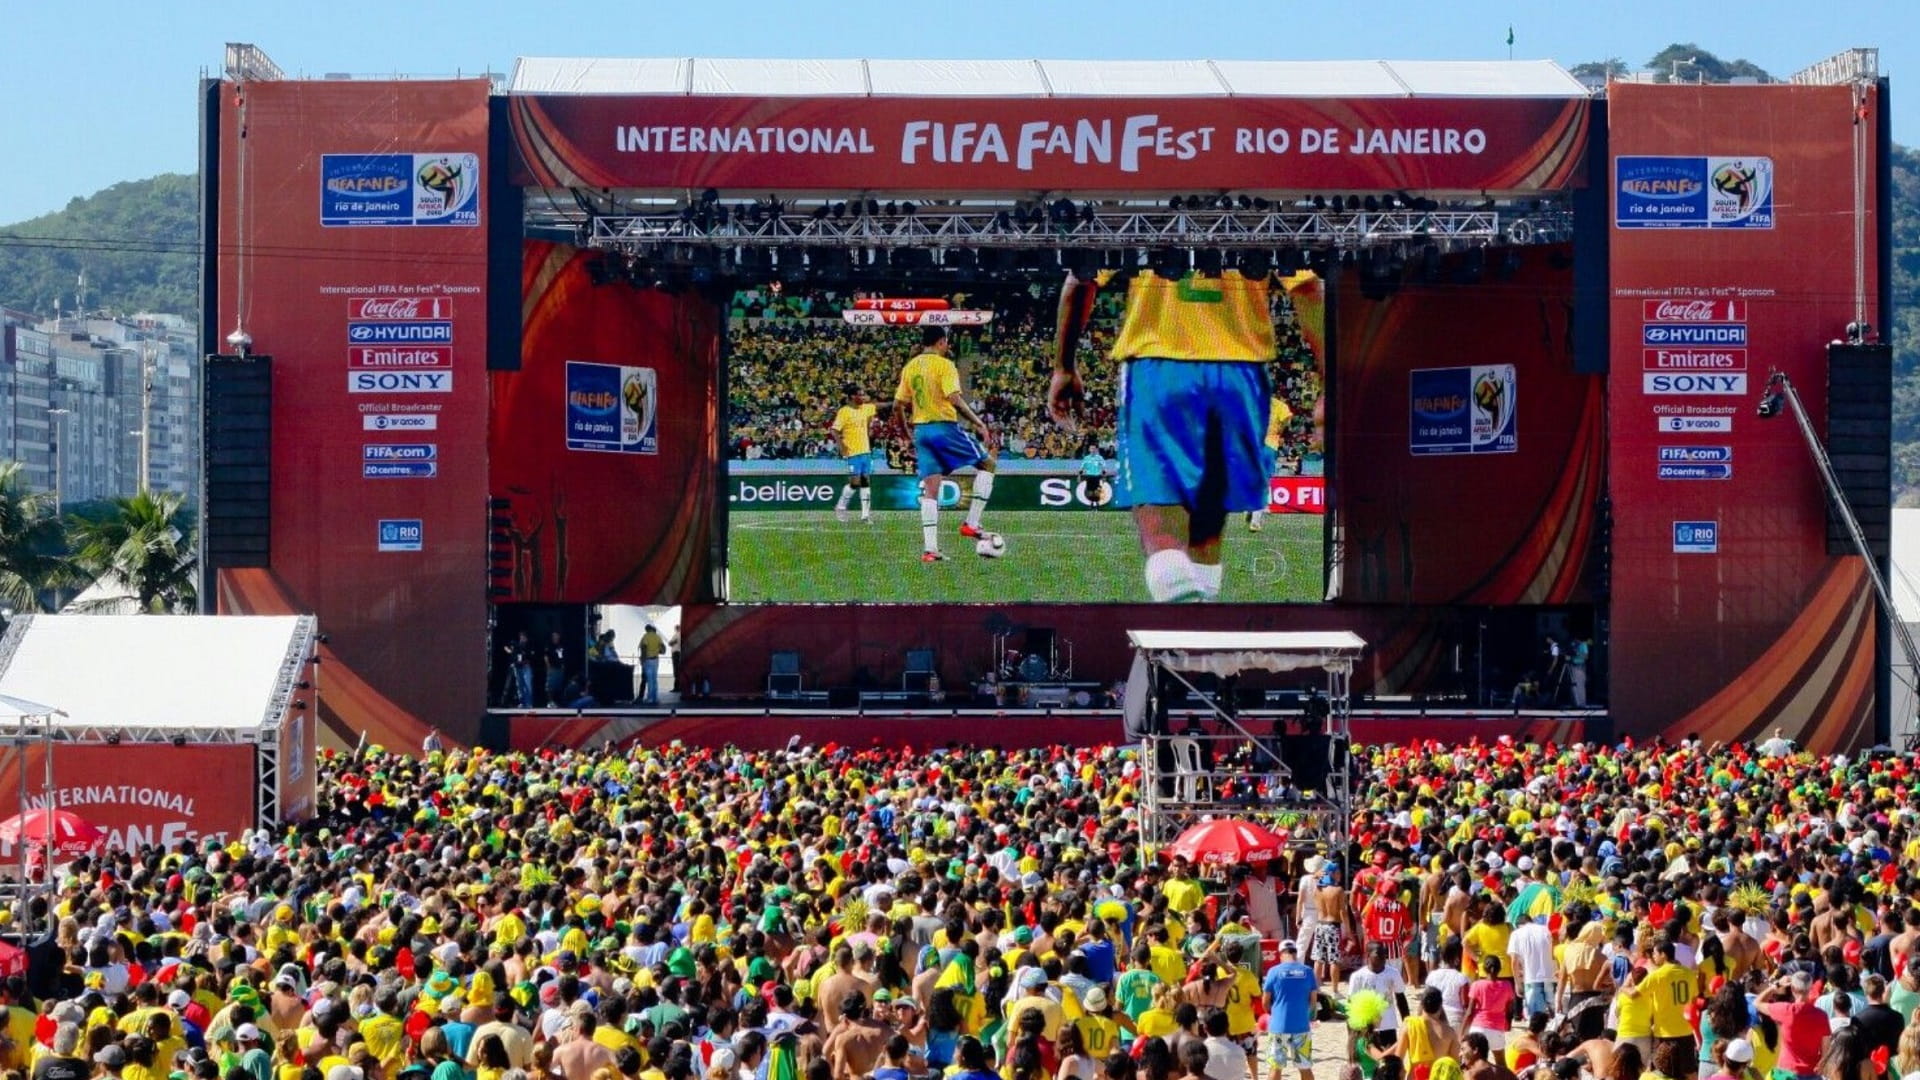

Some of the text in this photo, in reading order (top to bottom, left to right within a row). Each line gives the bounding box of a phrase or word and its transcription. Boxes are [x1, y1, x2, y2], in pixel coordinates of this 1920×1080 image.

[617, 114, 1487, 172] INTERNATIONAL FIFA FAN FEST RIO DE JANEIRO
[335, 201, 400, 213] rio de janeiro
[1629, 203, 1695, 215] rio de janeiro
[455, 211, 476, 219] FIFA
[1750, 215, 1770, 223] FIFA
[320, 285, 376, 294] International
[398, 285, 414, 294] Fan
[442, 285, 480, 296] Sponsors
[1616, 287, 1671, 296] International
[1737, 286, 1775, 297] Sponsors
[853, 314, 875, 323] POR
[889, 311, 898, 323] 0
[906, 311, 914, 323] 0
[928, 314, 949, 323] BRA
[375, 326, 450, 339] HYUNDAI
[1671, 329, 1744, 341] HYUNDAI
[362, 348, 439, 365] Emirates
[1657, 350, 1733, 367] Emirates
[358, 374, 444, 390] SONY
[1653, 376, 1739, 392] SONY
[359, 403, 442, 412] Official Broadcaster
[1653, 404, 1737, 414] Official Broadcaster
[400, 526, 418, 537] RIO
[1694, 528, 1714, 539] RIO
[1379, 916, 1395, 935] 10
[1671, 979, 1690, 1006] 10
[1088, 1027, 1105, 1050] 10
